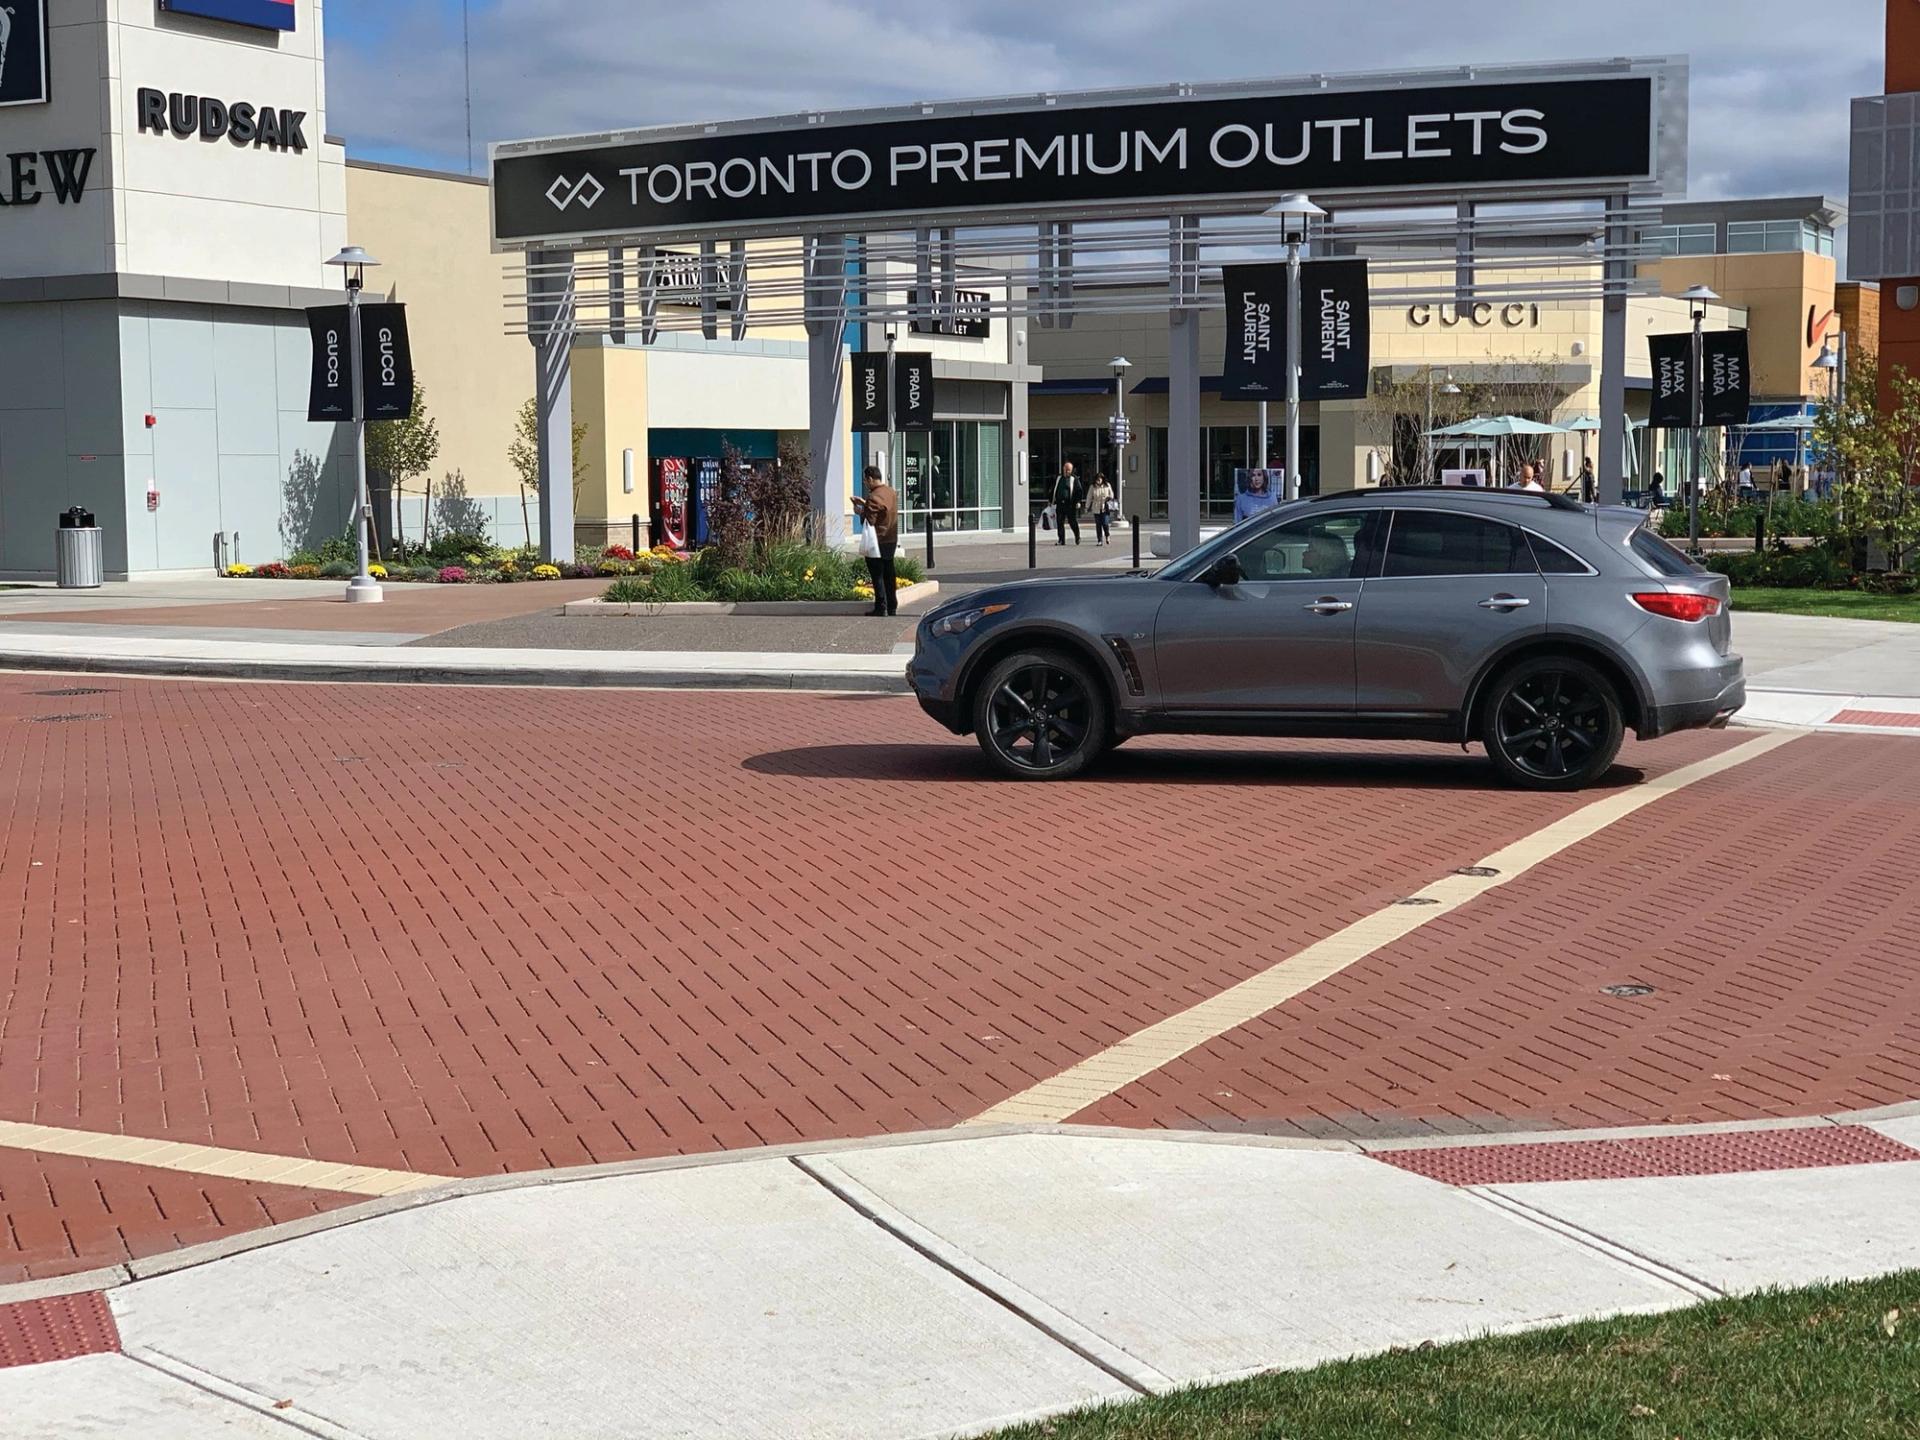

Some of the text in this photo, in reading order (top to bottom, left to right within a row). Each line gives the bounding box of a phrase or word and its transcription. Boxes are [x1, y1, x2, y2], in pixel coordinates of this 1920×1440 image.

[137, 87, 308, 150] RUDSAK
[0, 148, 97, 205] EW
[619, 108, 1549, 205] TORONTO PREMIUM OUTLETS
[1243, 291, 1256, 364] LAURENT
[1258, 303, 1270, 352] SAINT
[1320, 288, 1335, 363] LAURENT
[1336, 300, 1350, 350] SAINT
[1407, 302, 1538, 328] GUCCI
[326, 329, 339, 388] GUCCI
[379, 327, 395, 386] GUCCI
[1659, 357, 1672, 399] MARA
[1673, 361, 1685, 393] MAX
[1712, 353, 1725, 396] MARA
[1727, 357, 1740, 390] MAX
[865, 368, 876, 410] PRADA
[909, 367, 920, 410] PRADA
